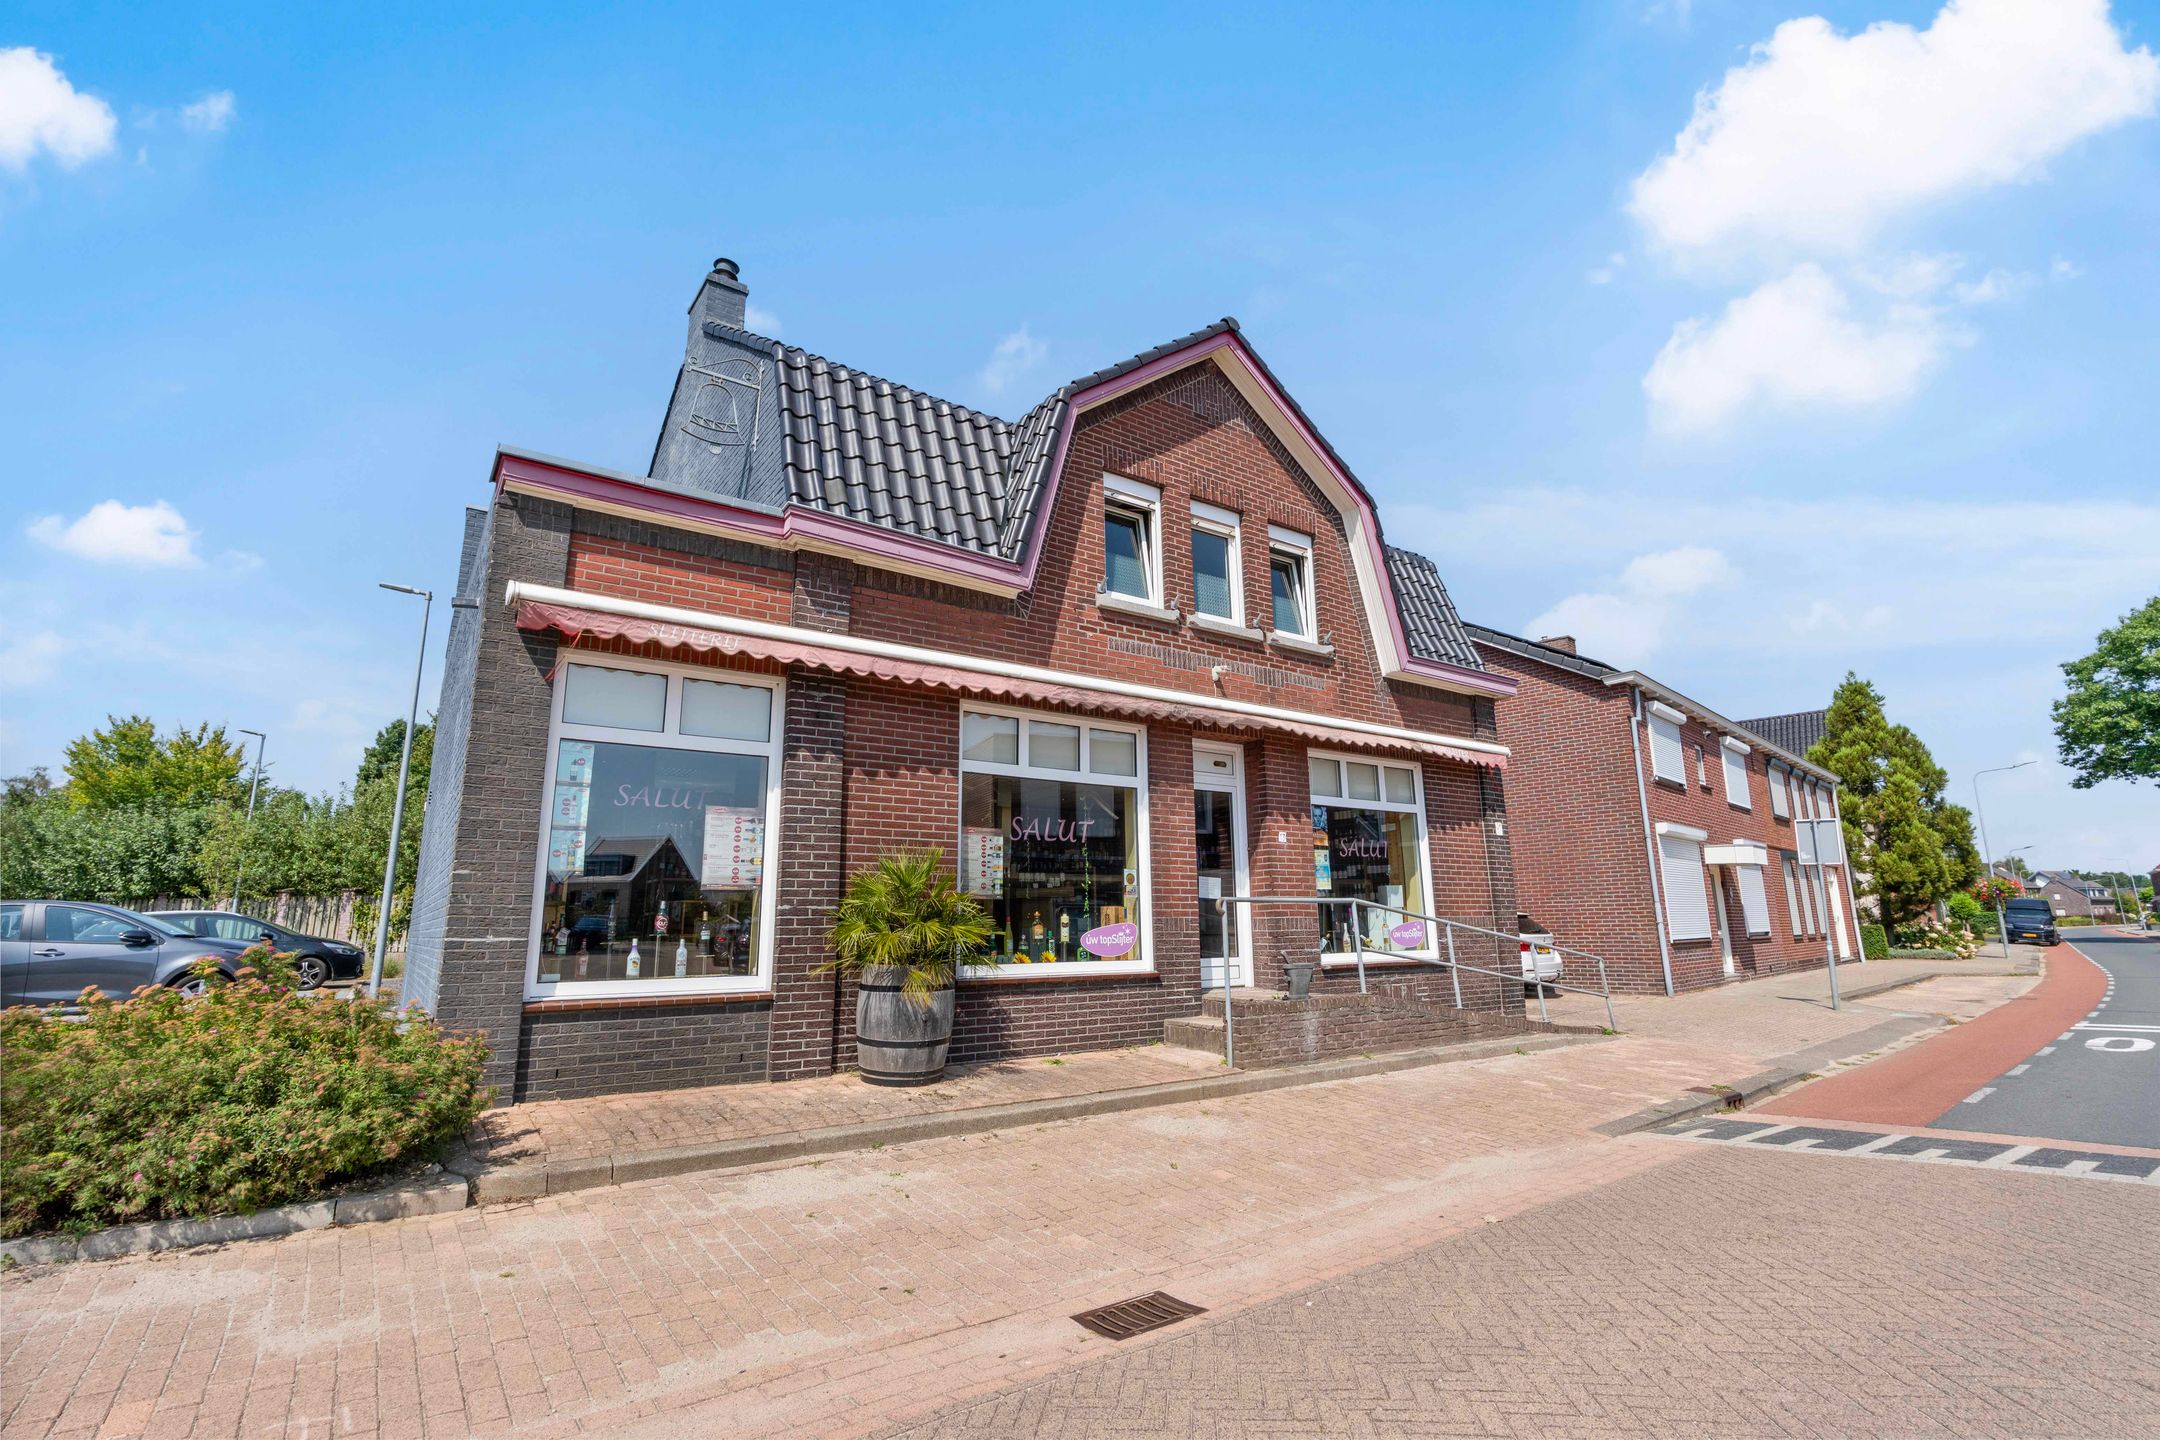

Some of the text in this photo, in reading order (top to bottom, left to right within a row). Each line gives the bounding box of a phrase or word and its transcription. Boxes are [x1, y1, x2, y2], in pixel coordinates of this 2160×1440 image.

[648, 624, 741, 650] SLIJTERIJ
[614, 784, 713, 810] SALUT
[1010, 816, 1095, 843] SALUT
